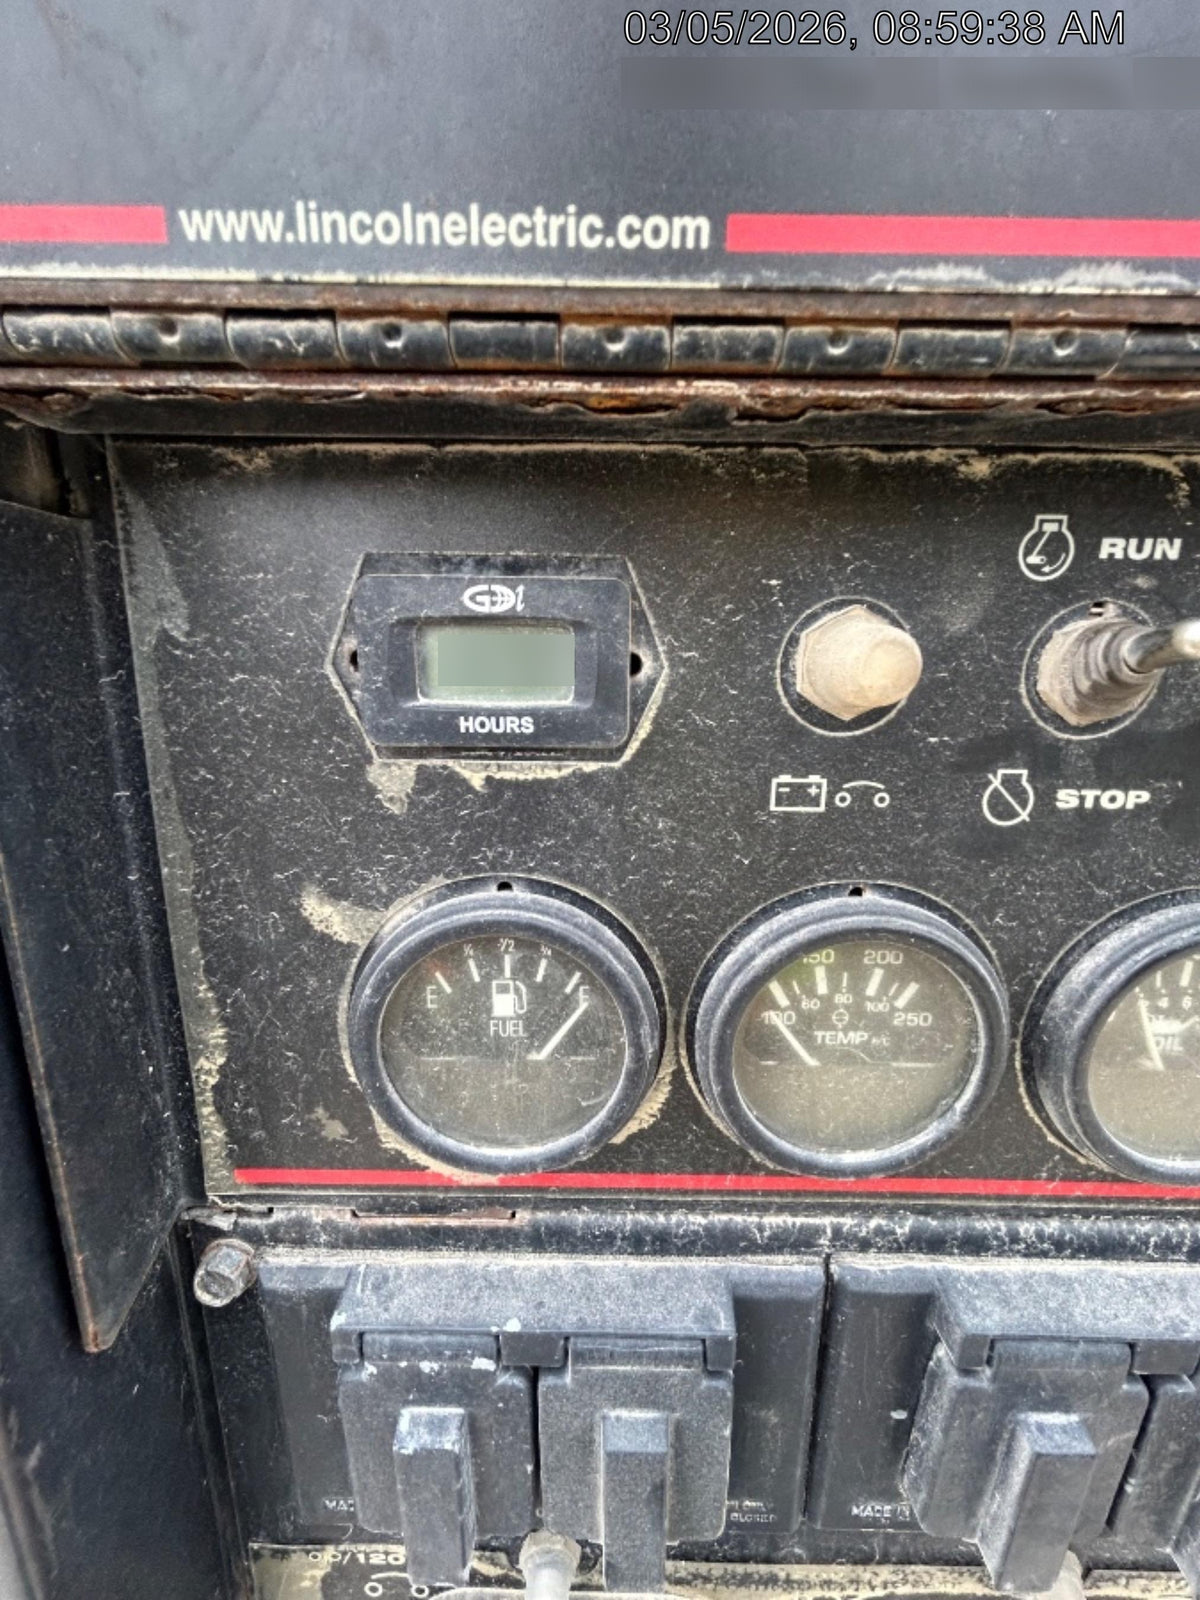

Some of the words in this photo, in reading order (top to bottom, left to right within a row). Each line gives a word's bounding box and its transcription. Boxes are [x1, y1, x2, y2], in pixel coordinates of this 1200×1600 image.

[178, 200, 711, 250] www.lincolnelectric.com
[1099, 537, 1182, 561] RUN
[459, 716, 535, 734] HOURS
[1056, 789, 1151, 810] STOP
[863, 949, 904, 965] 200
[426, 985, 438, 1009] E
[893, 1012, 933, 1027] 250
[489, 1020, 526, 1037] FUEL
[813, 1030, 868, 1045] TEMP
[851, 1504, 892, 1518] MADE
